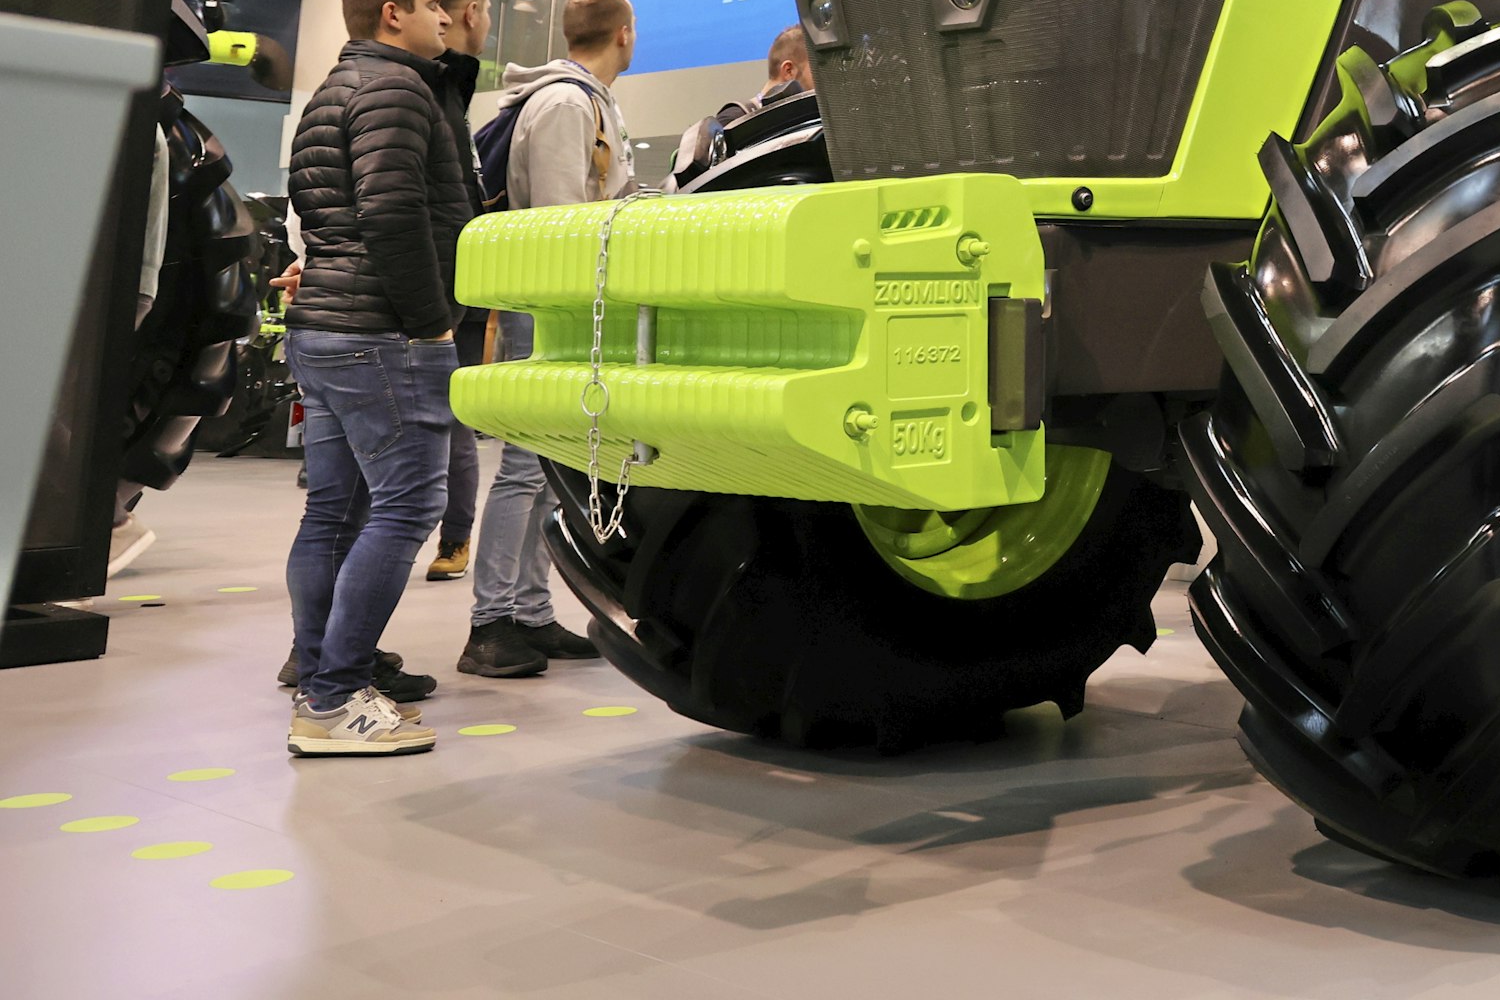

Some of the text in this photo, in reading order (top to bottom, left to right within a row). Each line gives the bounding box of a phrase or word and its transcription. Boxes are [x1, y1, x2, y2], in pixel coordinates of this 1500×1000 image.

[875, 280, 980, 307] ZOOMLION
[893, 345, 962, 365] 116372
[892, 420, 946, 459] 50Kg
